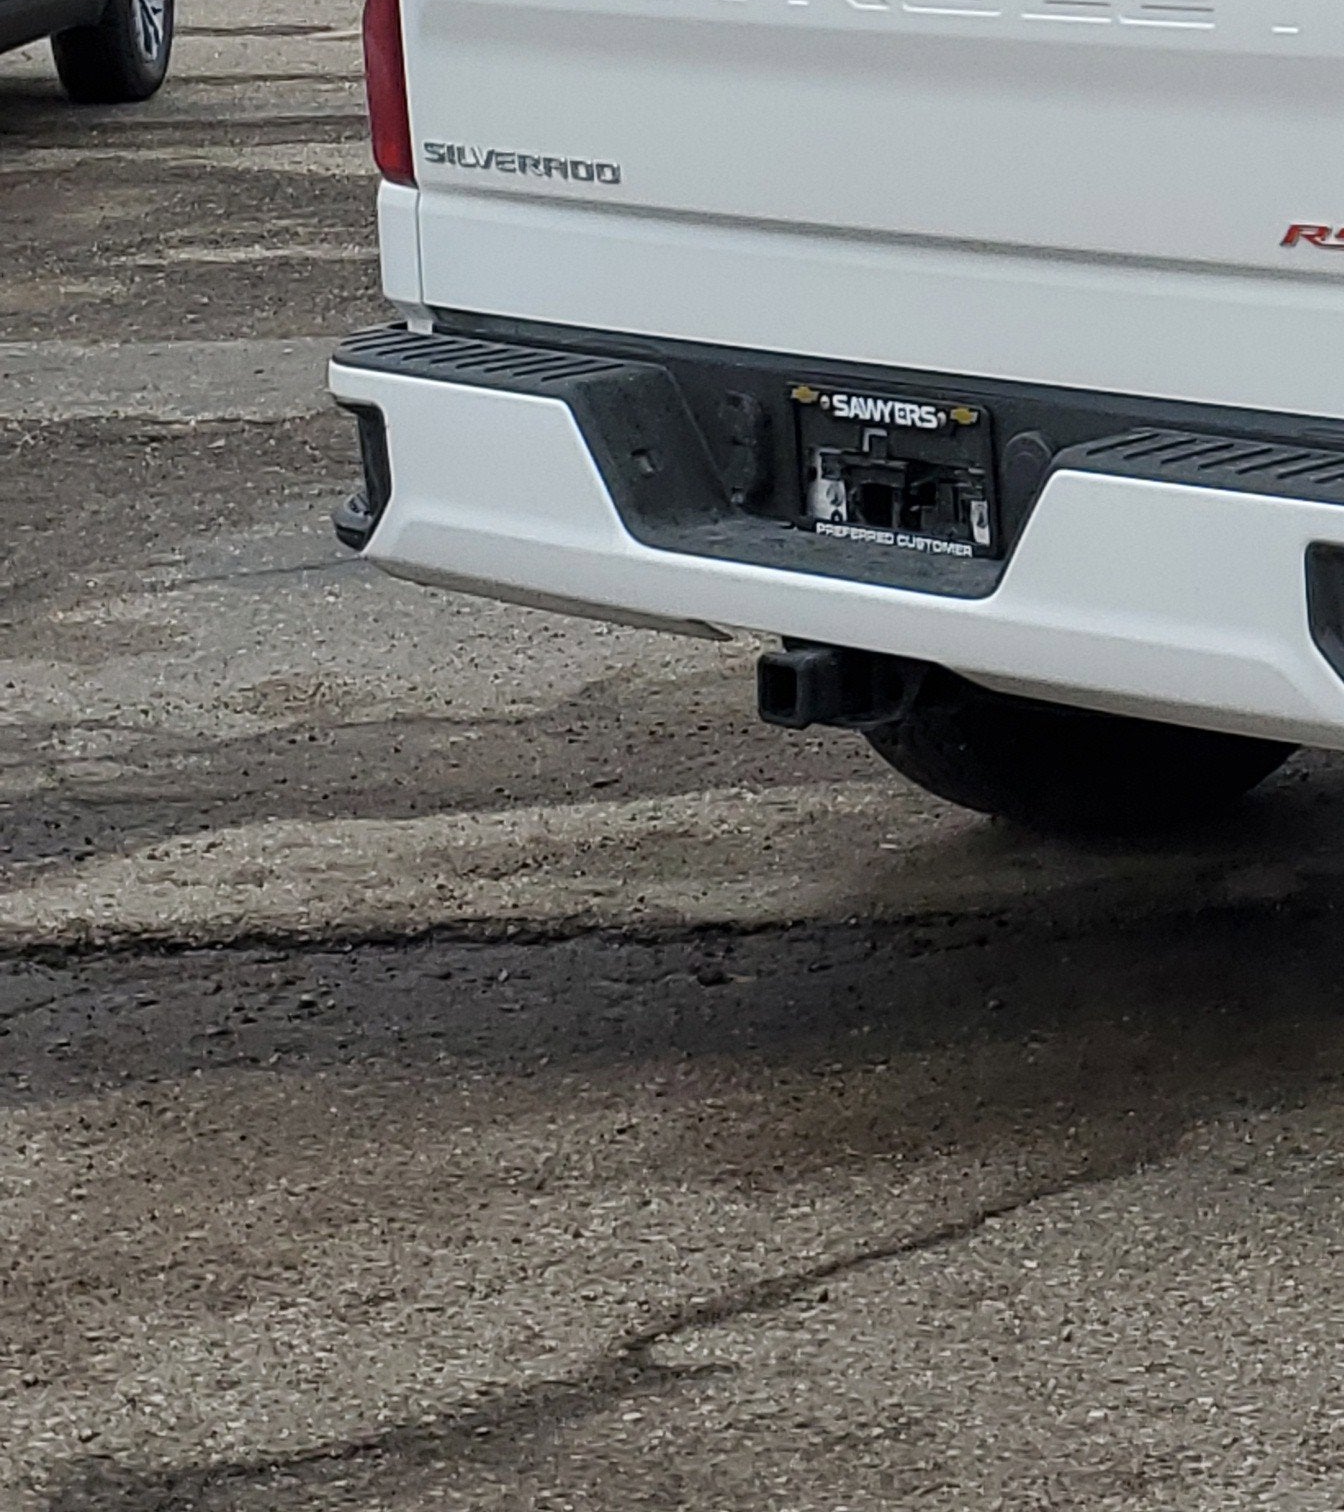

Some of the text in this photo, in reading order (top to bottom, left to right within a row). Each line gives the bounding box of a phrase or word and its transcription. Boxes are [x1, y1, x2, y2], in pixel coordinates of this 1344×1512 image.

[423, 141, 622, 185] SILVERADO
[832, 394, 939, 429] SAWYERS
[815, 522, 973, 558] PREFERRED CUSTOMER
